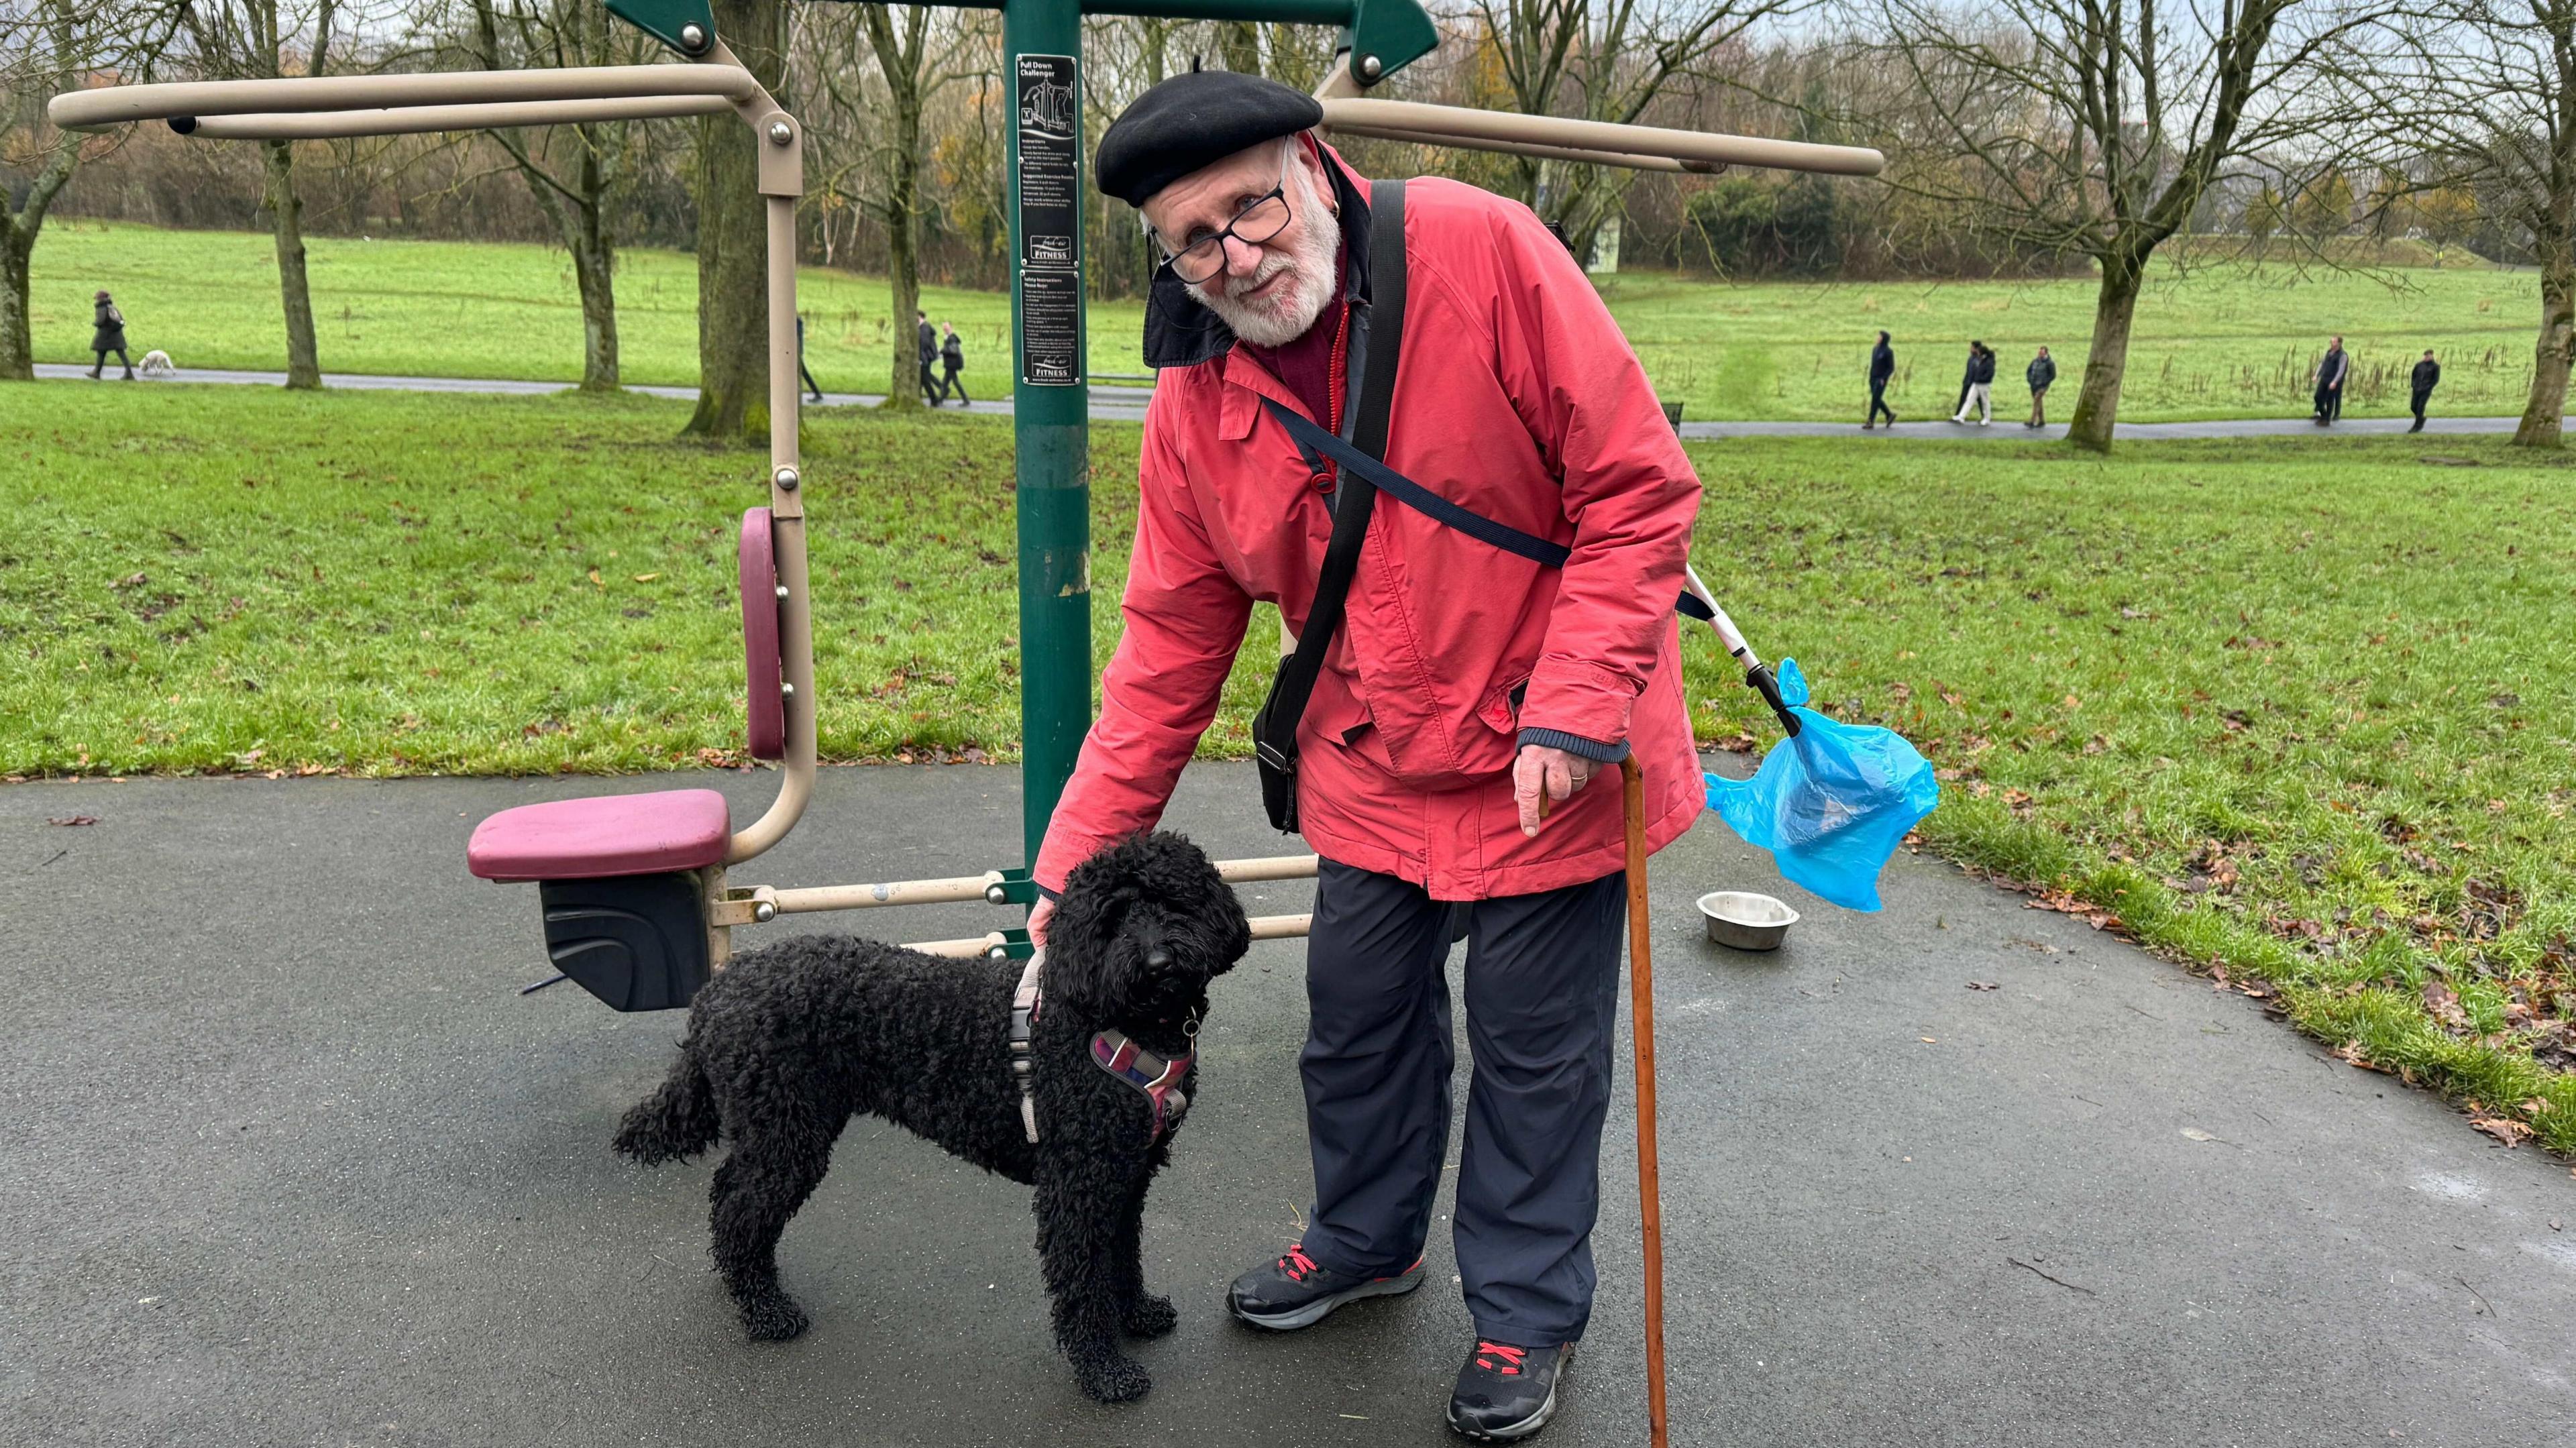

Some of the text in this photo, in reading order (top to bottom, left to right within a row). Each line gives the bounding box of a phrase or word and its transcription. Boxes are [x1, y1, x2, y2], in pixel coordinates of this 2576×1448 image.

[1033, 62, 1053, 70] Down
[1020, 69, 1055, 78] Challenger
[1035, 250, 1067, 259] FITNESS
